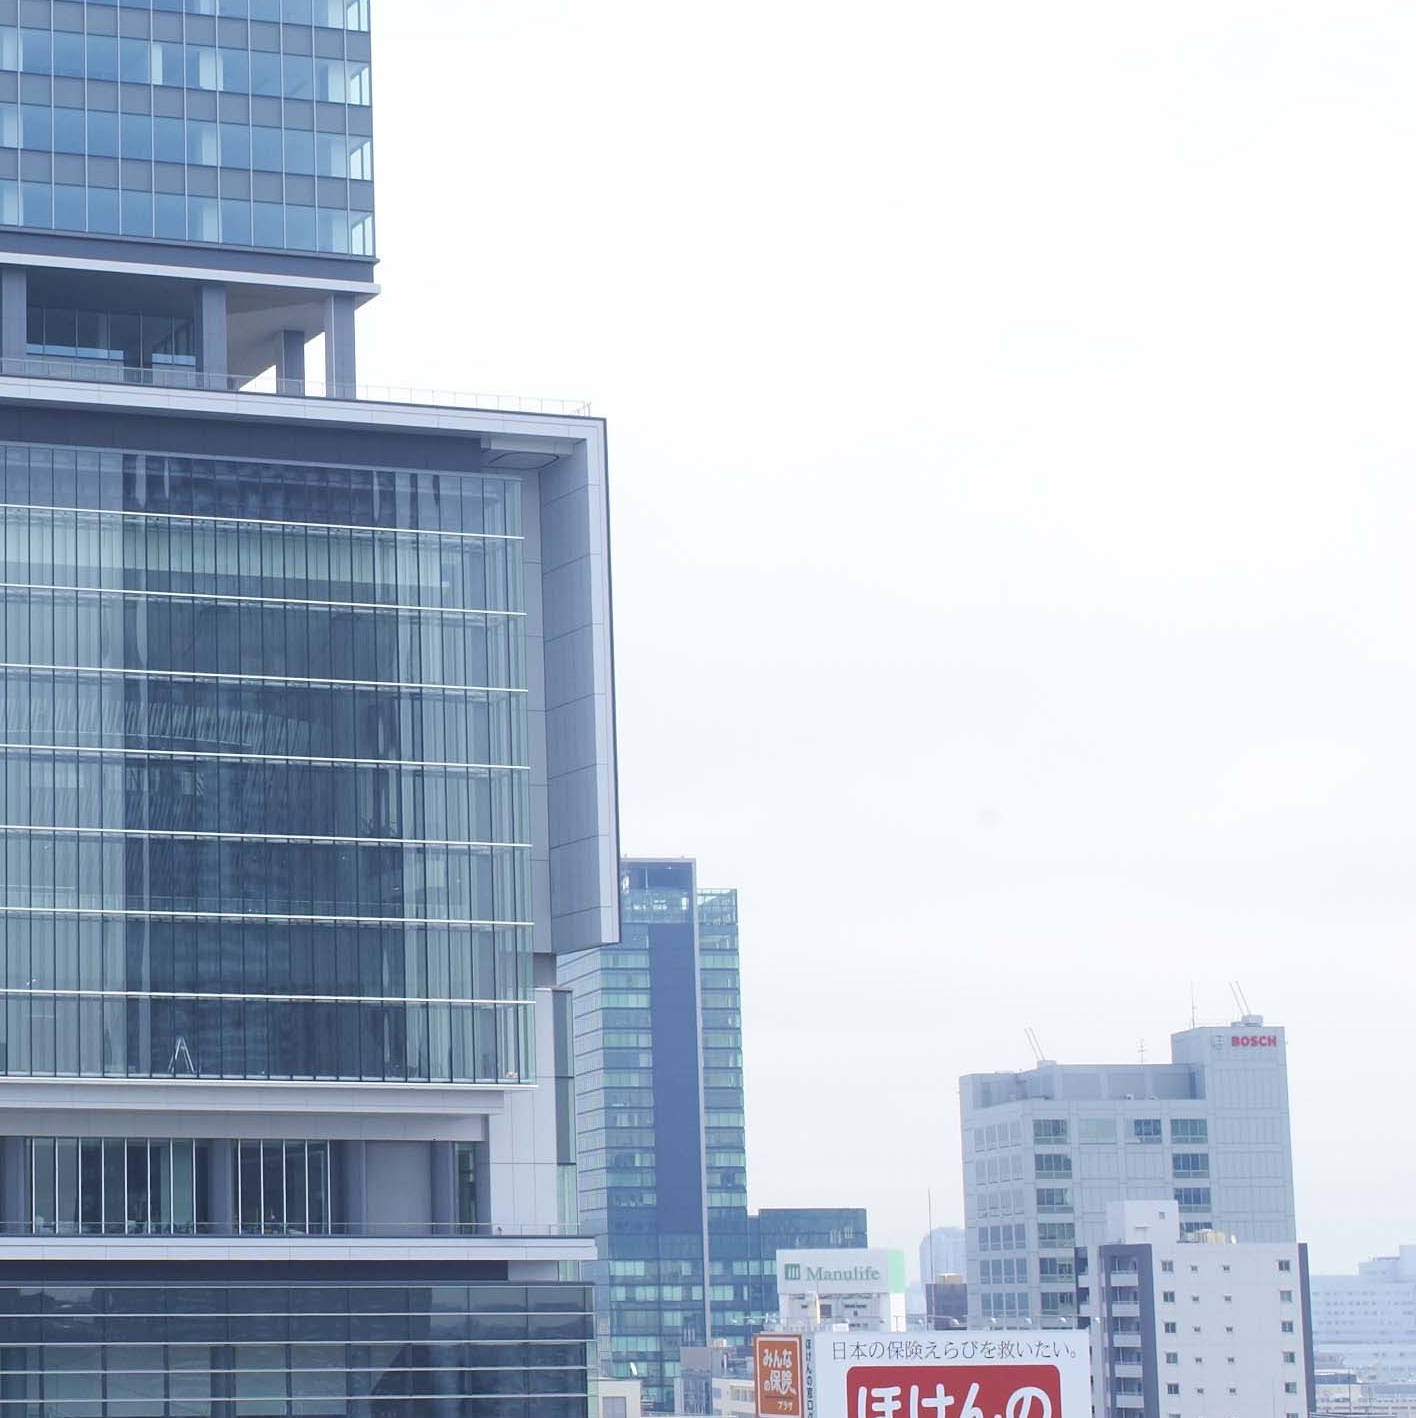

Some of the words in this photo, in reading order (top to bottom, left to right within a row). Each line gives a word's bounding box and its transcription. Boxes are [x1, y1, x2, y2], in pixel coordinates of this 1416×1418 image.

[1231, 1036, 1277, 1047] BOSCH
[806, 1265, 881, 1281] Manulife
[762, 1348, 793, 1368] みんな
[832, 1340, 1078, 1361] 日本の保険えらびを救いたい。
